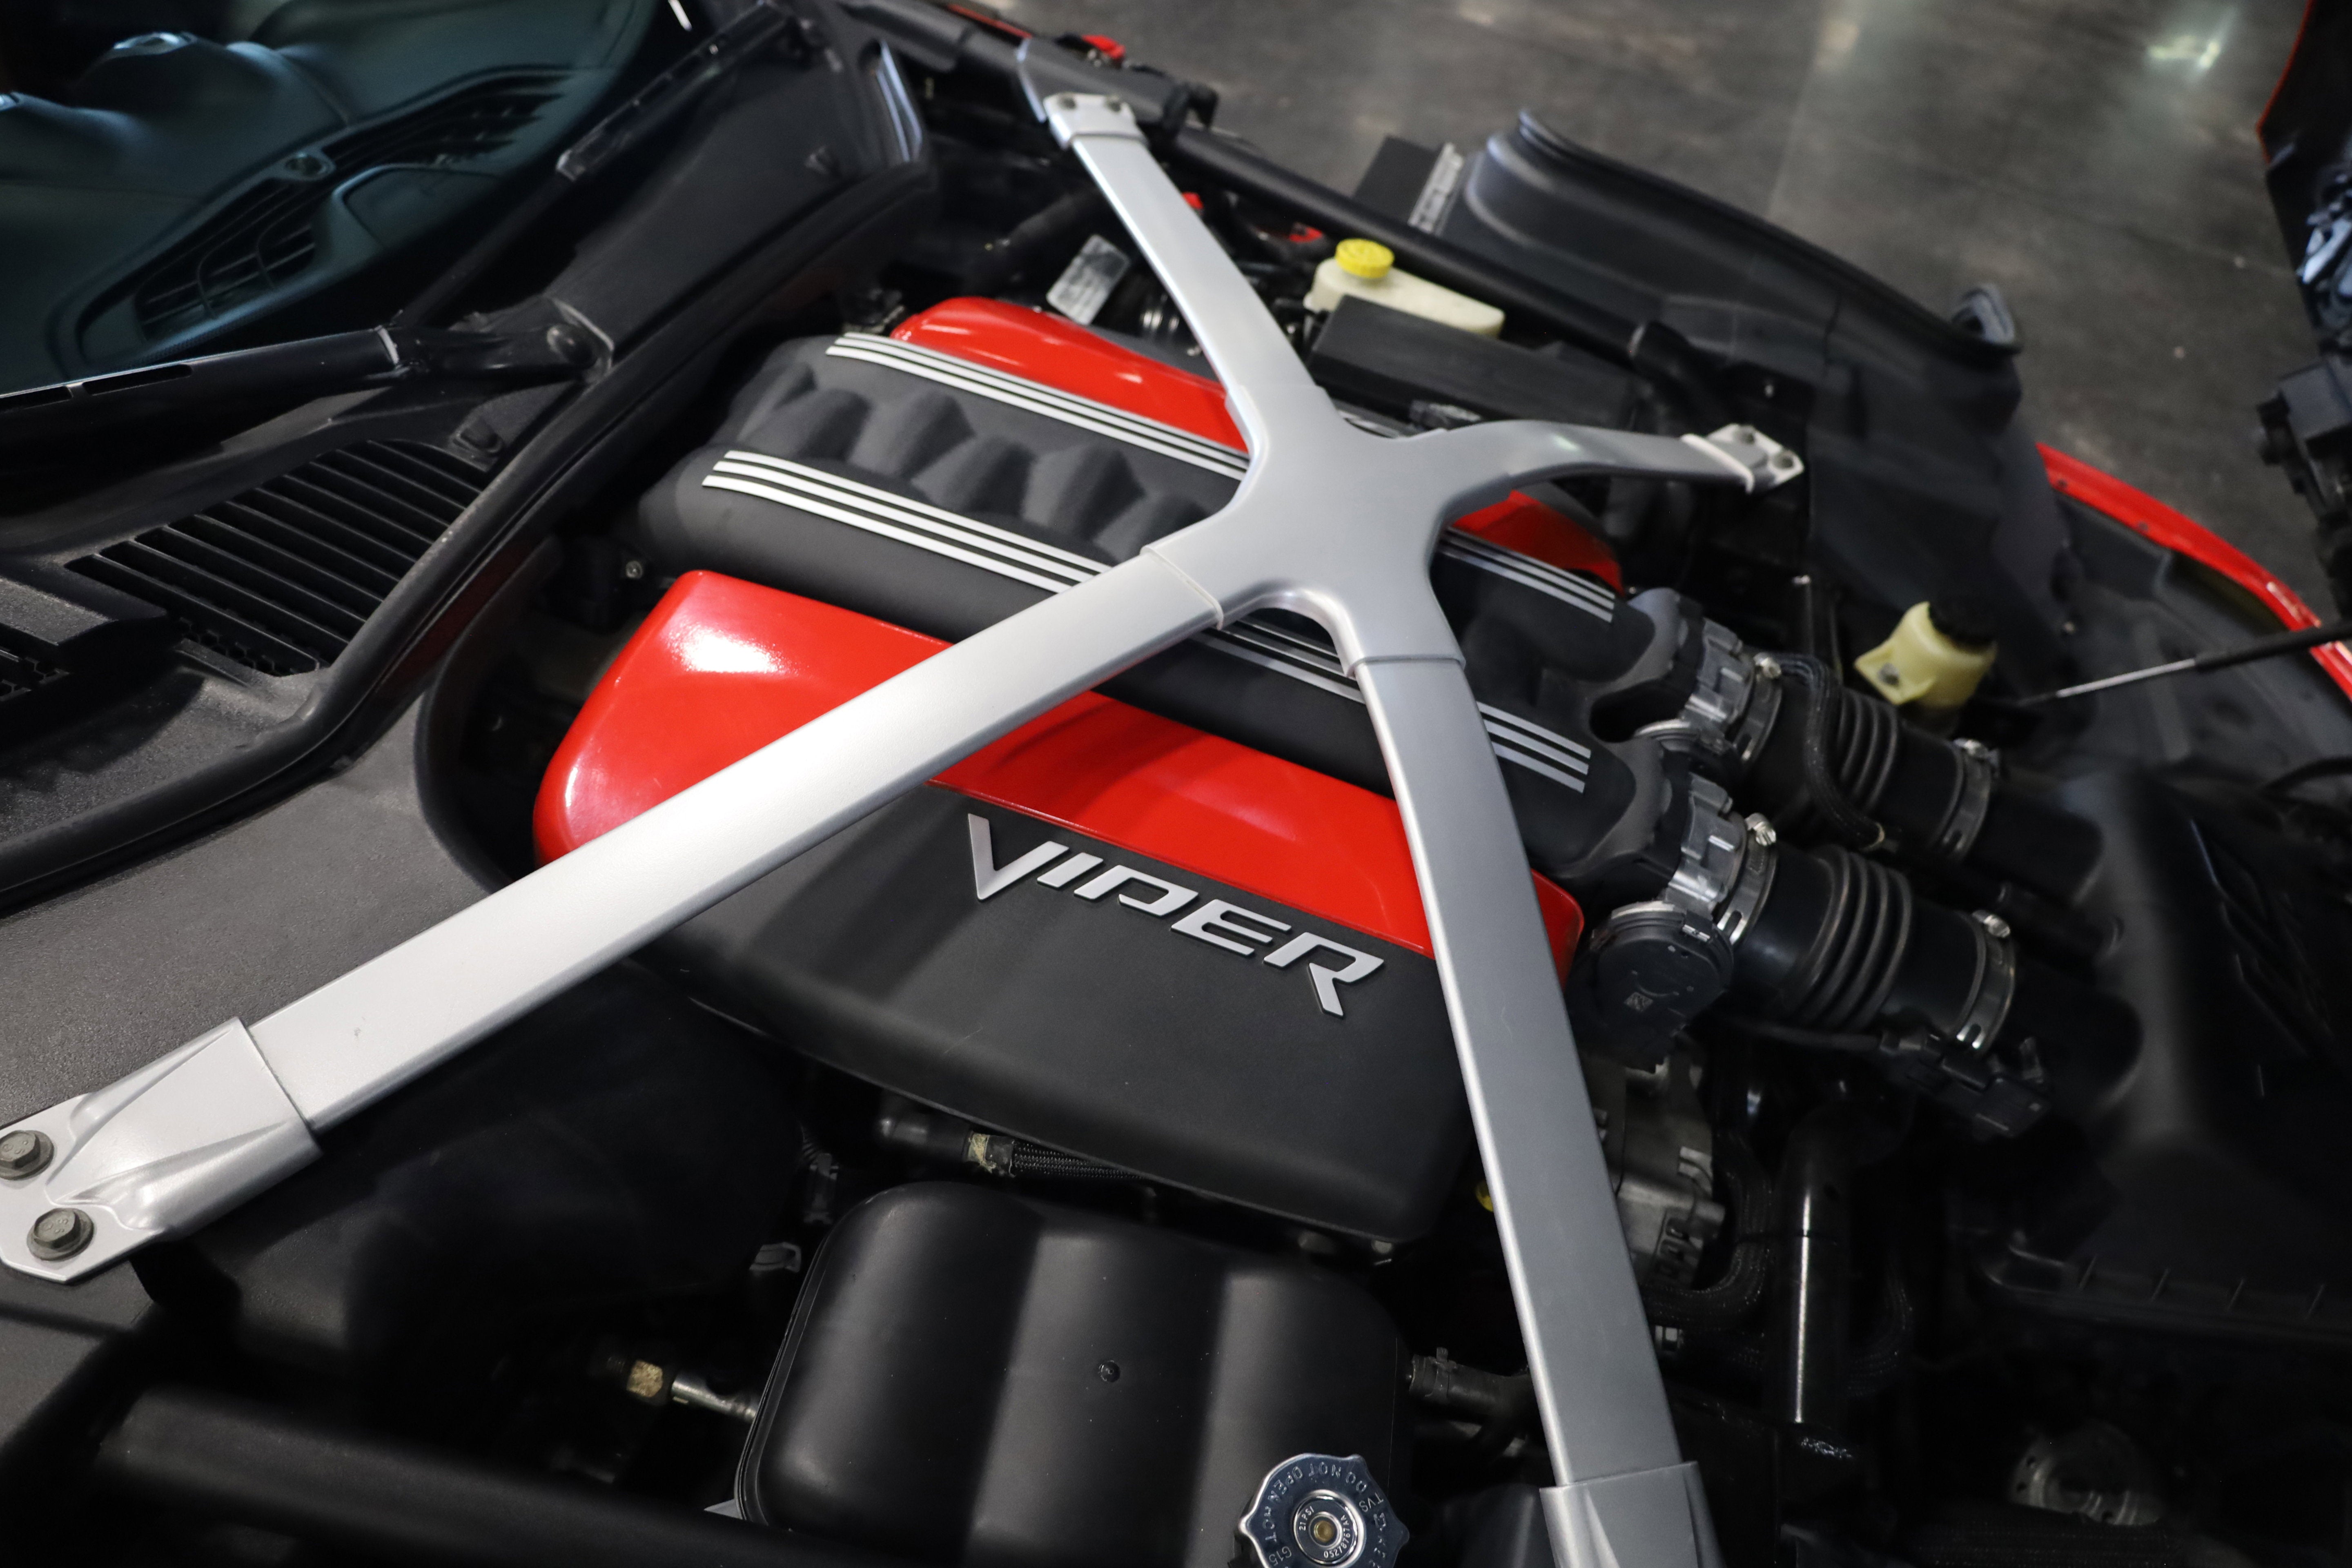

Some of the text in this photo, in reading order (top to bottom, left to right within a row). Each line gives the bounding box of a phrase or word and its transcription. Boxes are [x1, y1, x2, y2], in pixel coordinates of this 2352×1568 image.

[968, 814, 1384, 1017] VIPER
[1308, 1461, 1341, 1478] NOT
[1268, 1466, 1303, 1502] OPEN
[1345, 1472, 1367, 1492] DO
[1359, 1492, 1383, 1512] TVS
[1299, 1506, 1314, 1531] 21 PSI
[1324, 1515, 1350, 1558] 05278767AA
[1269, 1546, 1292, 1566] G15
